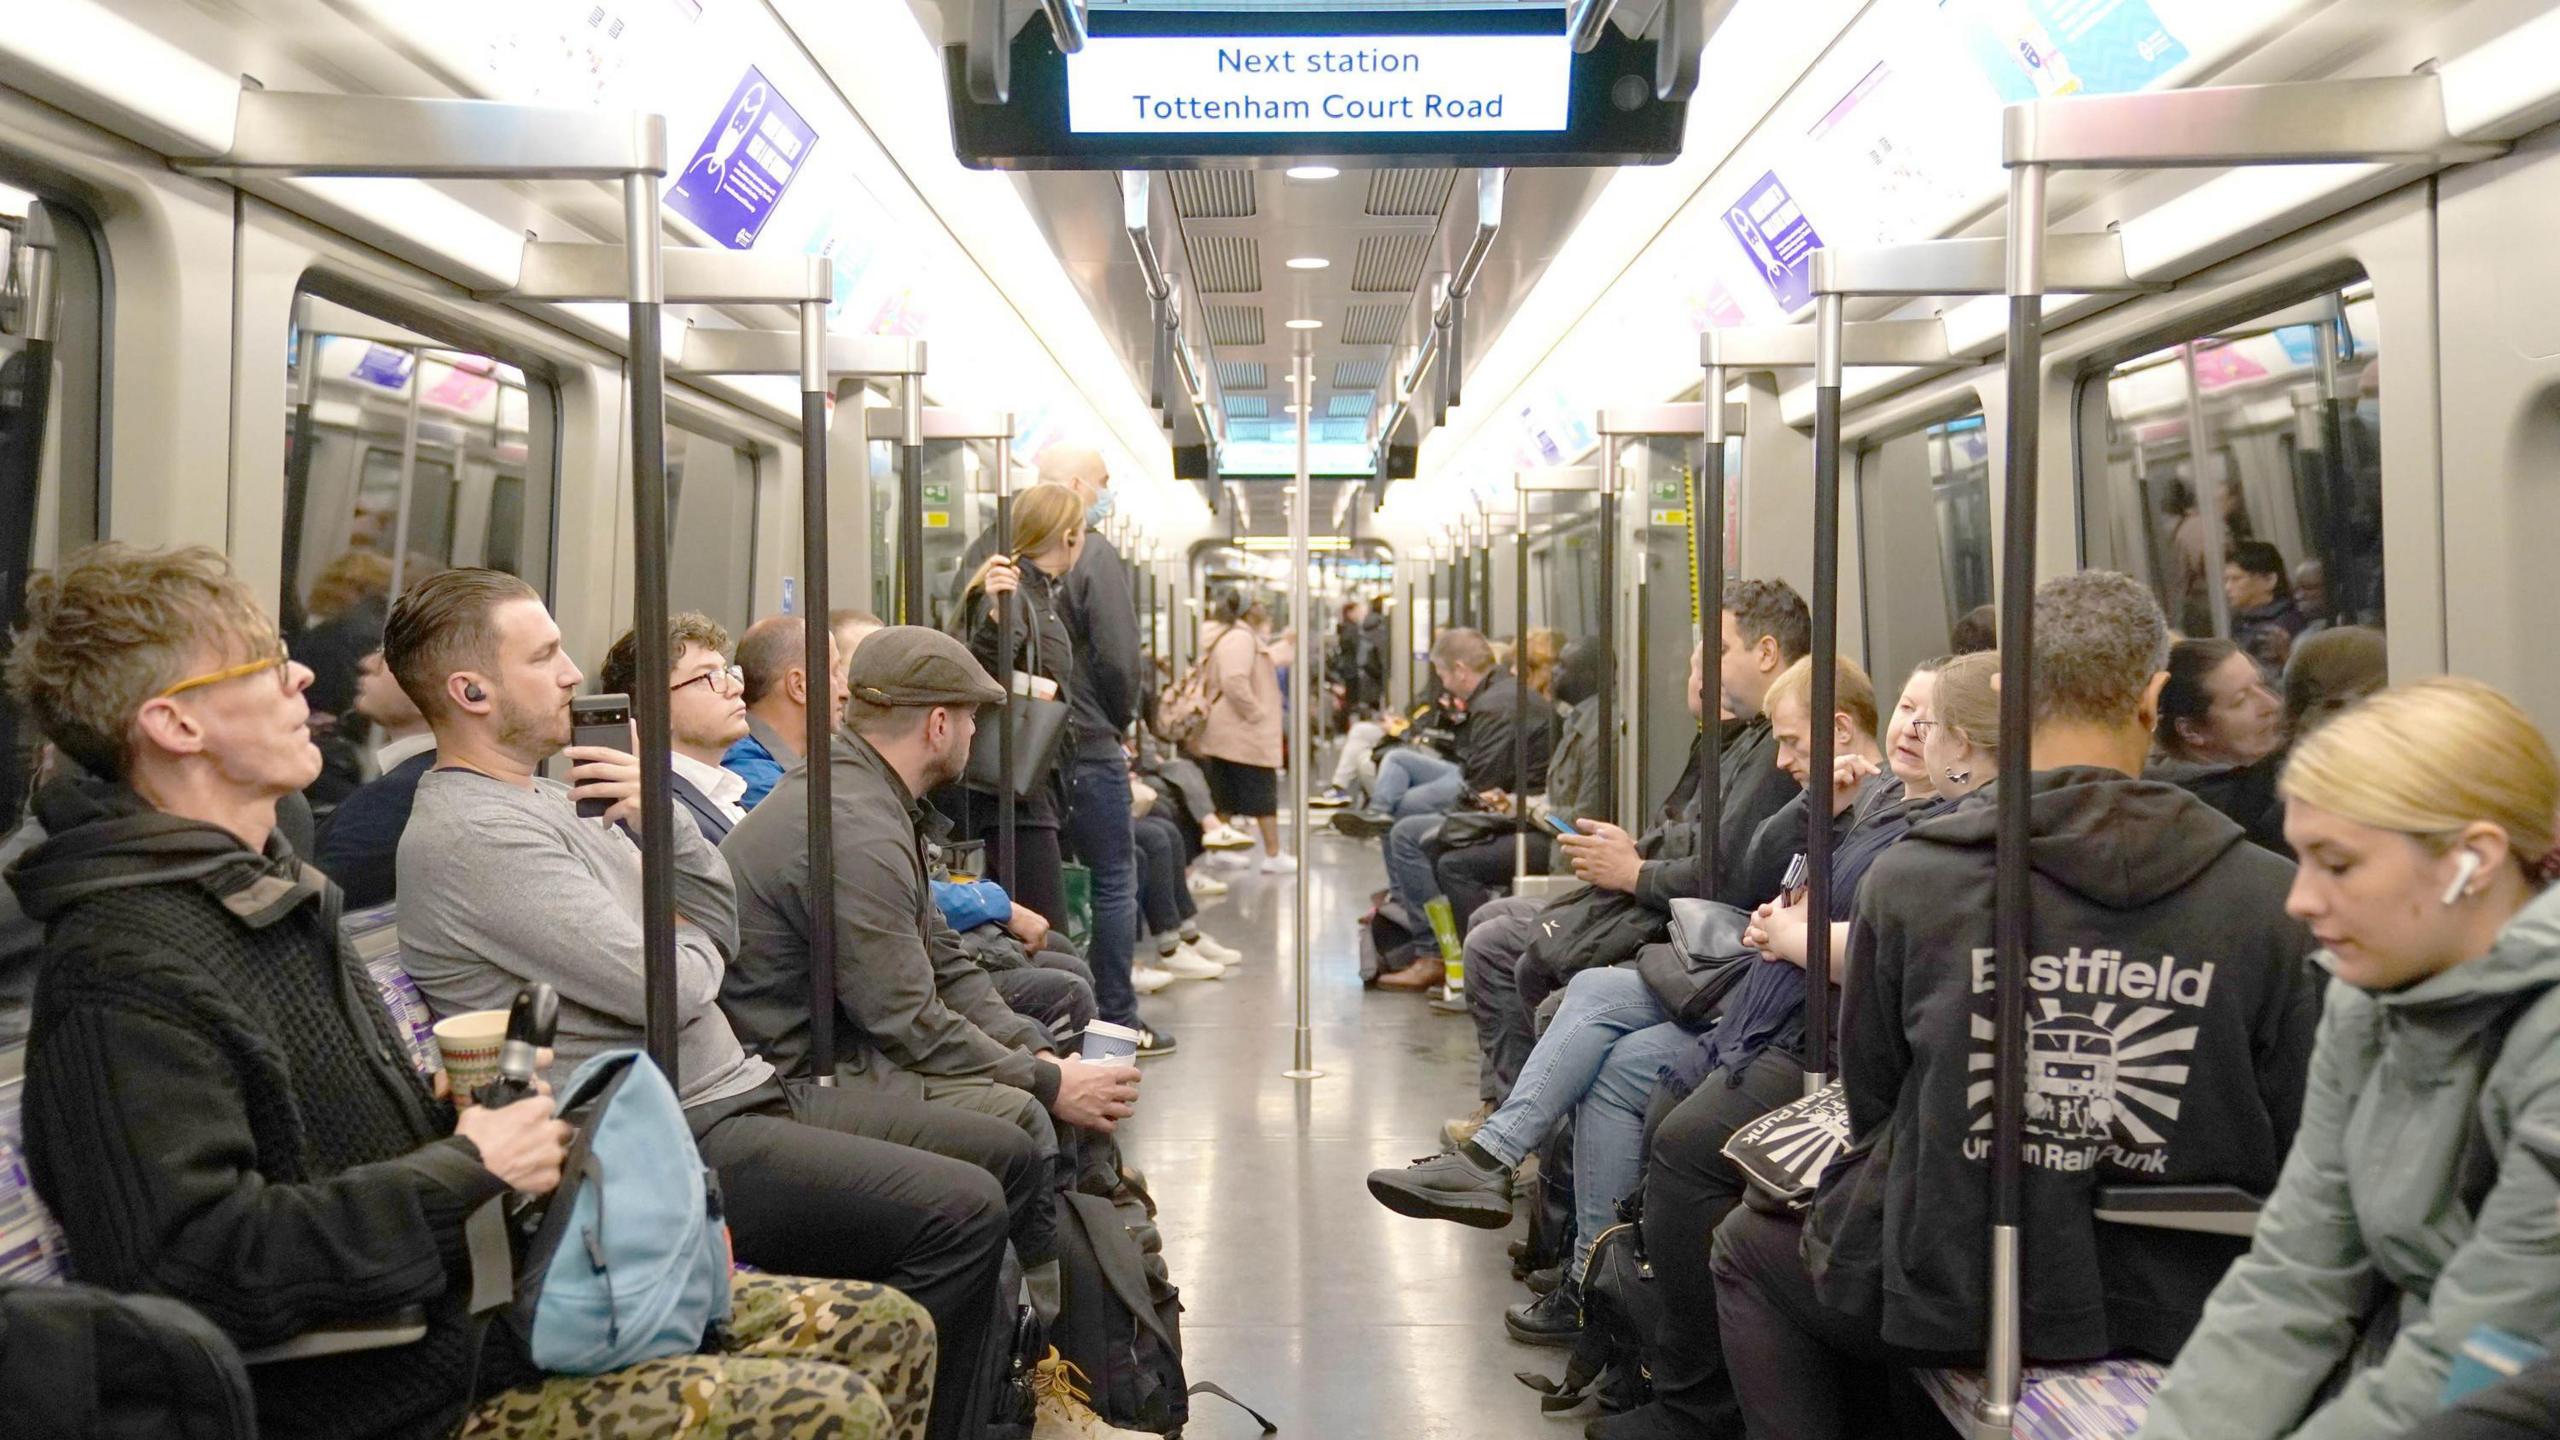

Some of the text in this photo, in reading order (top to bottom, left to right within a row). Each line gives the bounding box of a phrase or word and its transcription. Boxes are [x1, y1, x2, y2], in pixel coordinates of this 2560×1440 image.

[1218, 48, 1420, 73] Next station
[1132, 93, 1503, 119] Tottenham Court Road
[1971, 947, 2215, 1008] Estfield
[1740, 1108, 1795, 1145] Punk
[1962, 1135, 2169, 1174] Urn Rail Punk
